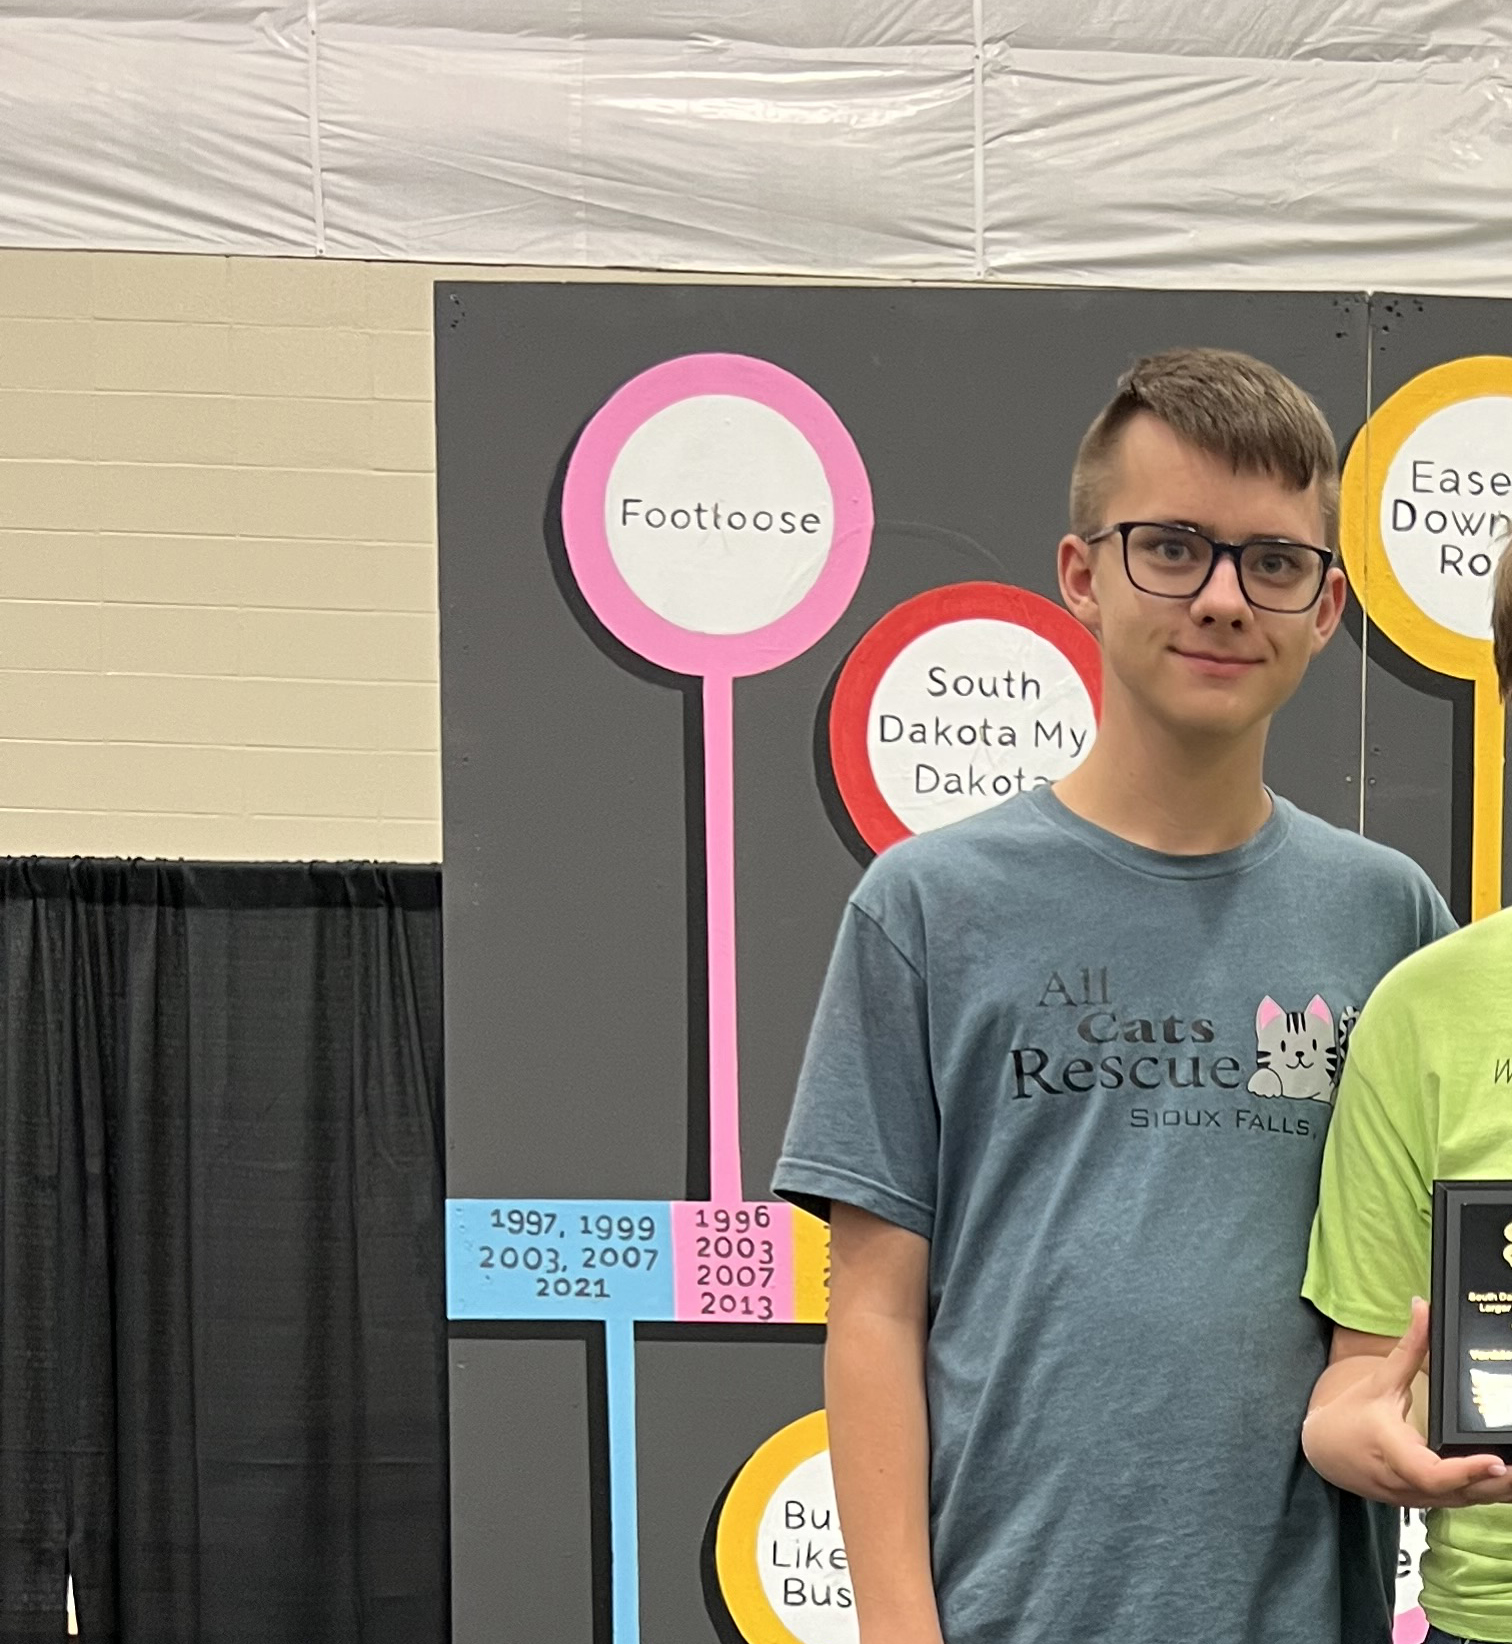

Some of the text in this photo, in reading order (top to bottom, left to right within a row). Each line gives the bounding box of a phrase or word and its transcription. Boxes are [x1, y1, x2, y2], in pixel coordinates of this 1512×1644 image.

[1412, 460, 1512, 496] Ease
[622, 498, 821, 534] Footloose
[1391, 499, 1512, 537] Down
[926, 666, 1041, 701] South
[879, 714, 1088, 758] Dakota My
[1037, 966, 1113, 1008] All
[1077, 1011, 1215, 1045] Cats
[1009, 1047, 1241, 1100] Rescue
[490, 1208, 657, 1241] 1997, 1999
[695, 1206, 771, 1234] 1996
[478, 1246, 659, 1274] 2003, 2007
[696, 1237, 775, 1265] 2003
[535, 1277, 612, 1299] 2021
[696, 1266, 775, 1288] 2007
[700, 1292, 775, 1321] 2013
[1468, 1292, 1498, 1302] South
[1479, 1303, 1512, 1314] Larger
[772, 1539, 848, 1570] Like
